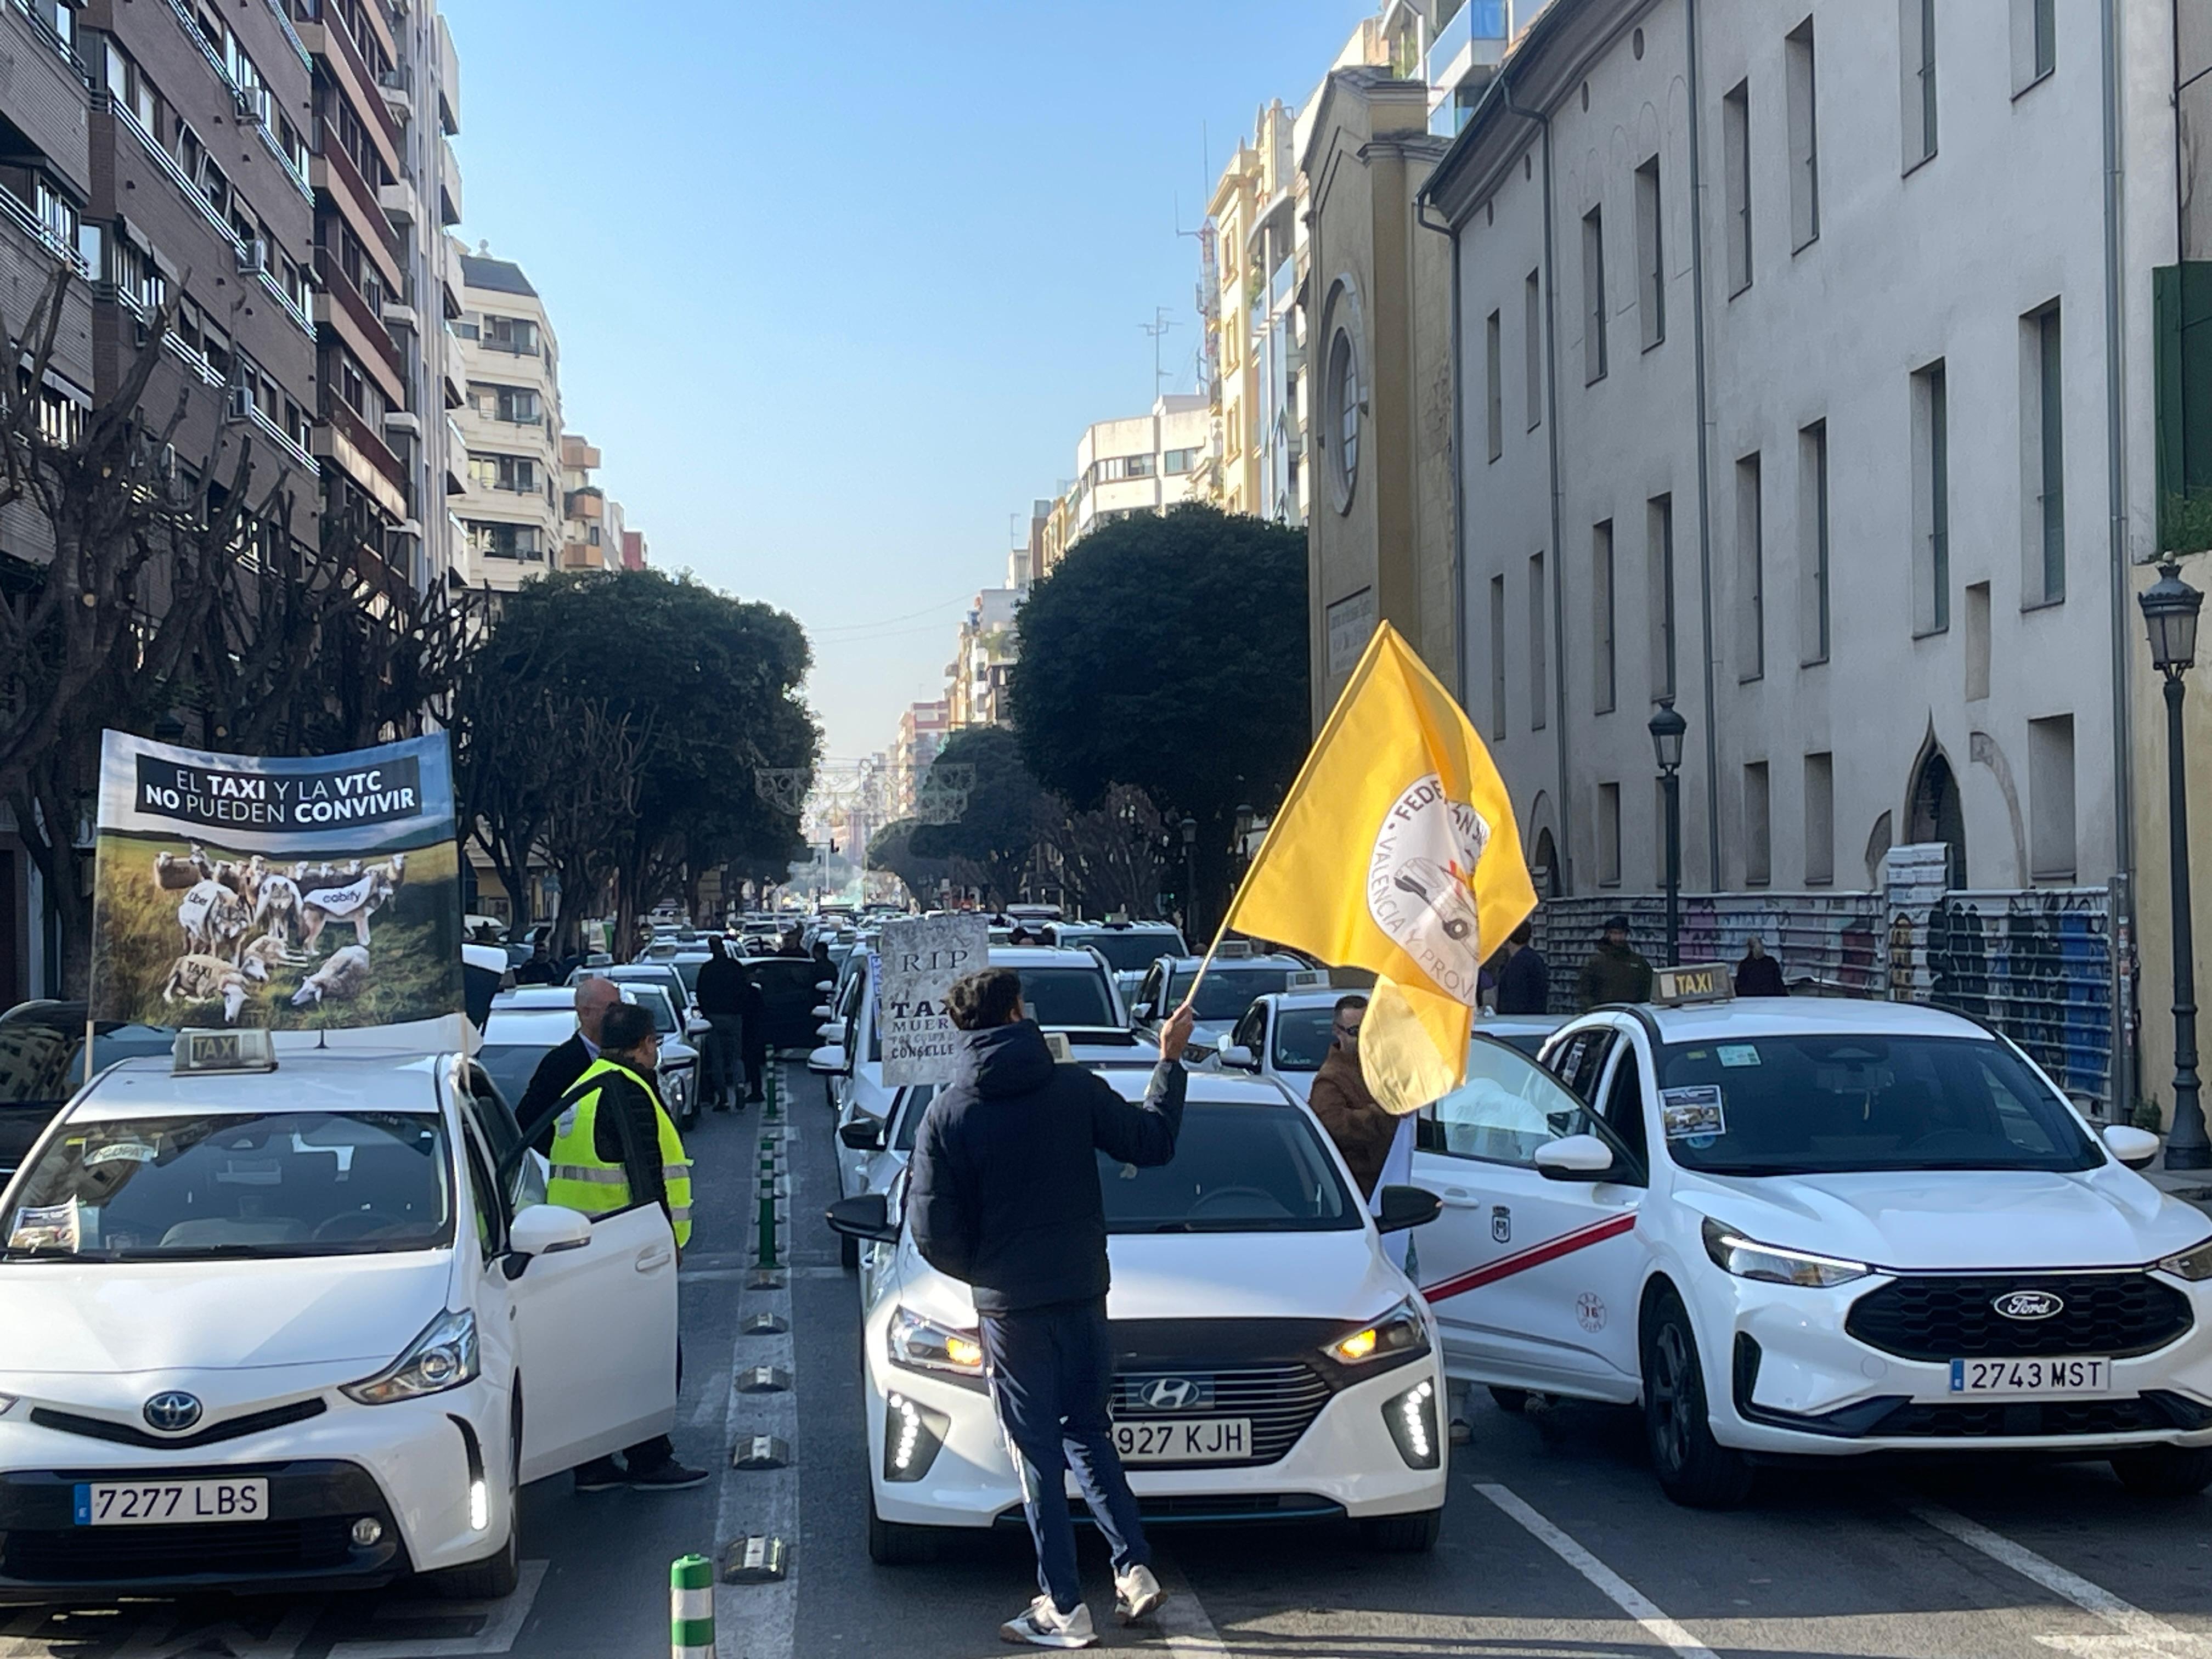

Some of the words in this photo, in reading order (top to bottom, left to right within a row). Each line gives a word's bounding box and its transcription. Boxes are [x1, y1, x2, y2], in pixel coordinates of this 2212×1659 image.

[176, 770, 201, 792] EL
[207, 775, 266, 799] TAXI
[274, 781, 290, 801] Y
[298, 780, 329, 801] LA
[335, 770, 382, 796] VTC
[145, 784, 180, 809] NO
[187, 795, 284, 823] PUEDEN
[295, 788, 415, 822] CONVIVIR
[1395, 780, 1444, 821] FEDE
[1372, 836, 1406, 933] VALENCIA
[1406, 929, 1423, 946] Y
[187, 961, 212, 980] TAXI
[1676, 972, 1713, 995] TAXI
[891, 1018, 949, 1032] MUER
[195, 1037, 238, 1059] TAXI
[891, 1043, 954, 1062] CONSELLE
[2007, 1295, 2051, 1314] Ford
[1972, 1363, 2042, 1389] 2743
[2051, 1362, 2102, 1388] MST
[1118, 1426, 1173, 1454] 927
[1186, 1423, 1242, 1453] KJH
[99, 1487, 183, 1519] 7277
[196, 1486, 257, 1515] LBS
